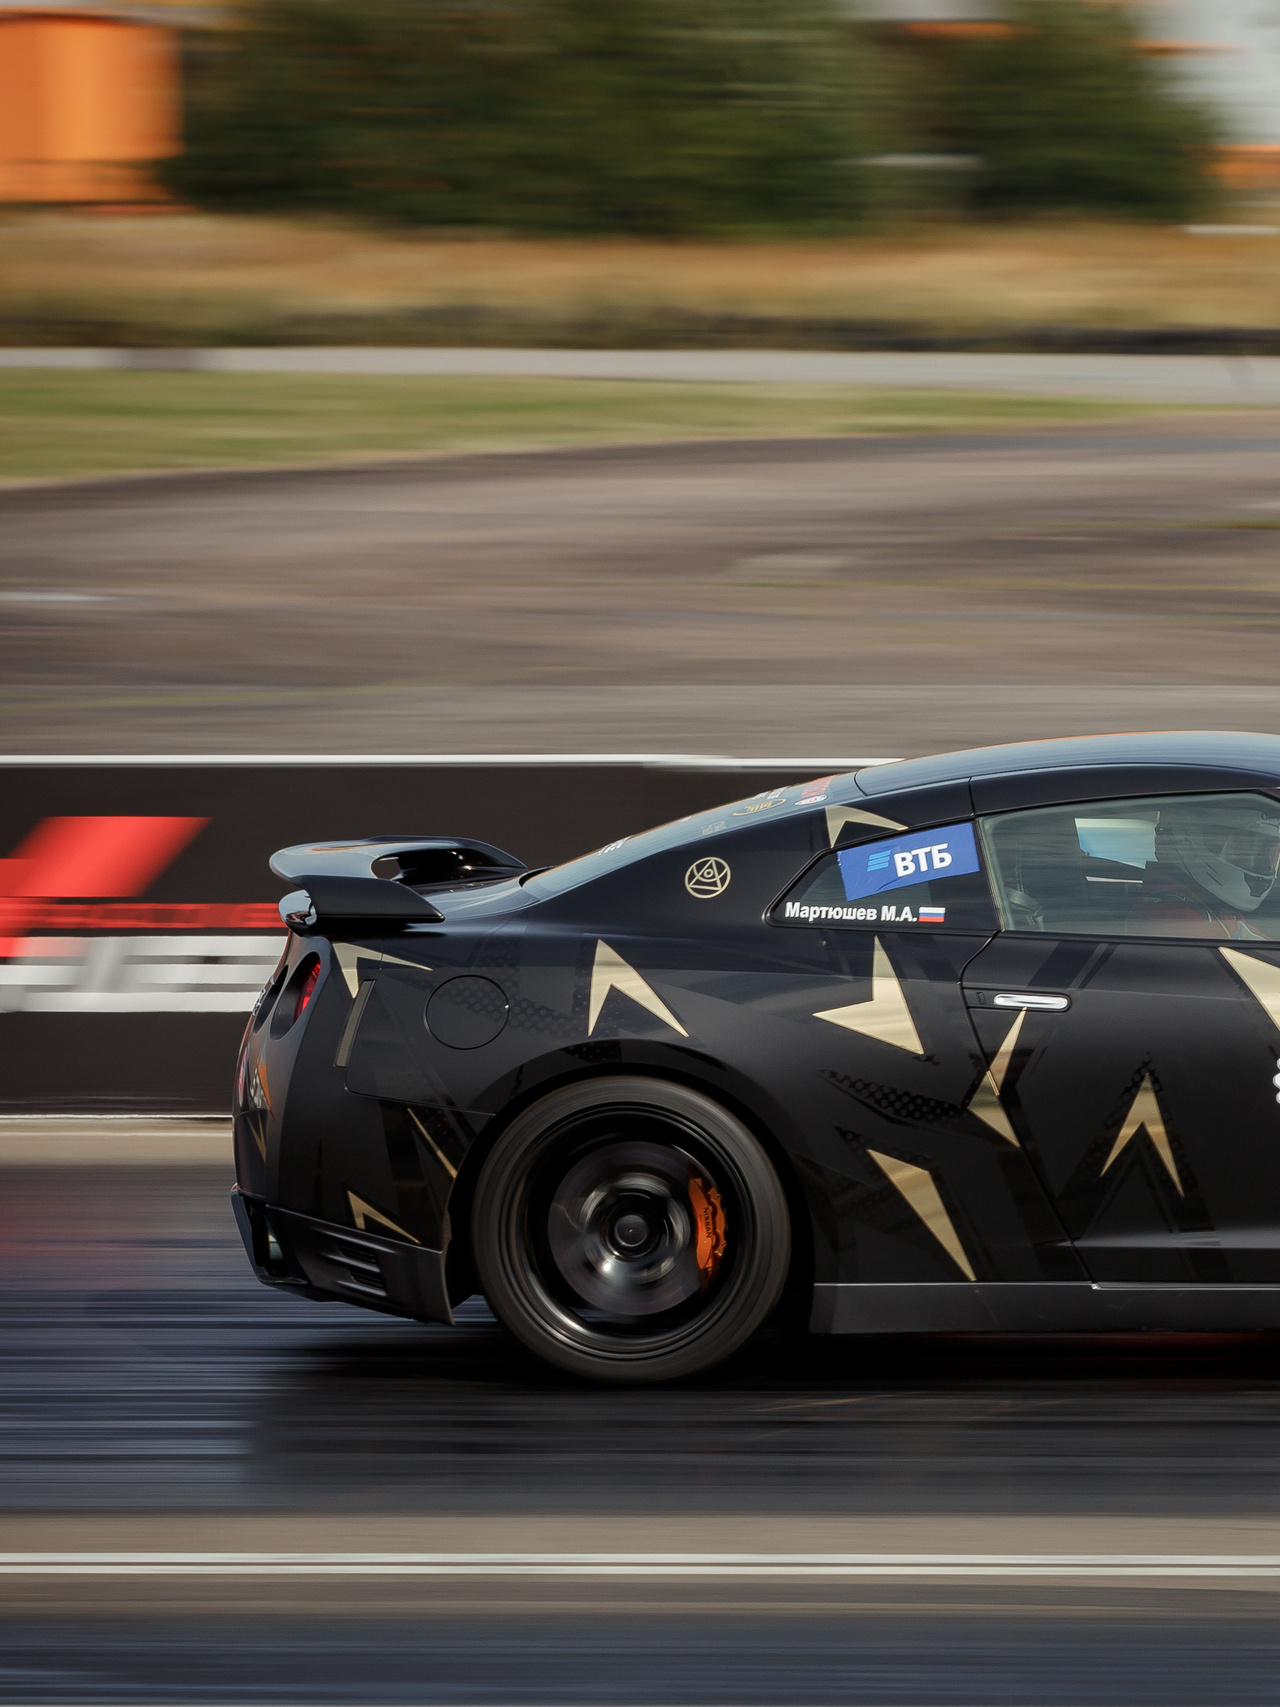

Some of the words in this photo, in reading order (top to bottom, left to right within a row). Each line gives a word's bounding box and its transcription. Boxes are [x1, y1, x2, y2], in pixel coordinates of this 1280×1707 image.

[893, 843, 953, 878] ВТБ
[784, 901, 878, 924] Мартюшев
[880, 905, 918, 922] М.А.
